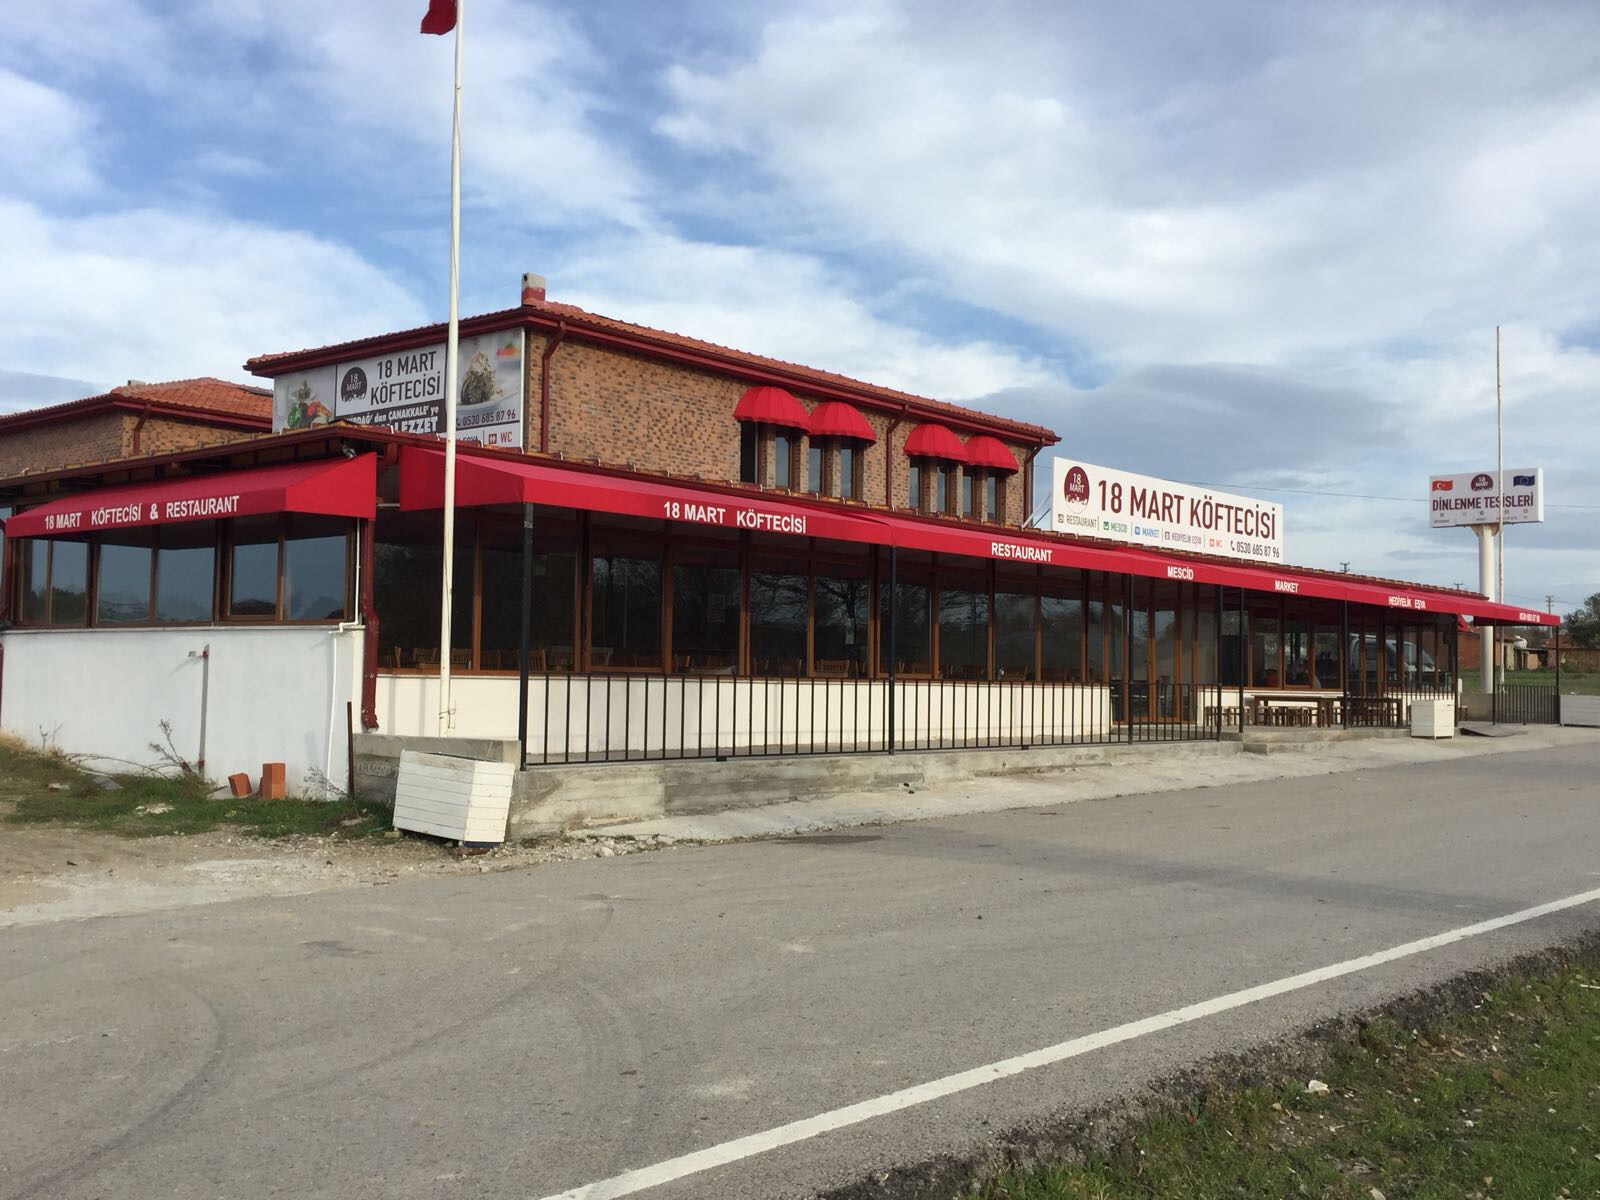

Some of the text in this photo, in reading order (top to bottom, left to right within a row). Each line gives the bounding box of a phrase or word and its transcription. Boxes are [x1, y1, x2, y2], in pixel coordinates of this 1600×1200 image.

[378, 351, 436, 379] 18 MART
[350, 374, 358, 383] 18
[346, 382, 362, 391] MART
[370, 371, 440, 406] KÖFTECİSİ
[431, 406, 439, 416] ye
[463, 409, 516, 426] 0530 685 87 96
[501, 432, 512, 442] WC
[1074, 473, 1081, 484] 18
[1070, 483, 1085, 494] MART
[1098, 480, 1275, 540] 18 MART KÖFTECİSİ
[1432, 496, 1481, 511] DİNLENME
[45, 515, 54, 529] 18
[56, 512, 82, 529] MART
[150, 503, 158, 520] &
[166, 496, 240, 518] RESTAURANT
[664, 501, 806, 534] 18 MART KÖFTECİSİ
[1066, 515, 1096, 528] RESTAURANT
[991, 542, 1052, 562] RESTAURANT
[1237, 542, 1279, 558] 0530 685 87 96
[1274, 580, 1299, 593] MARKET
